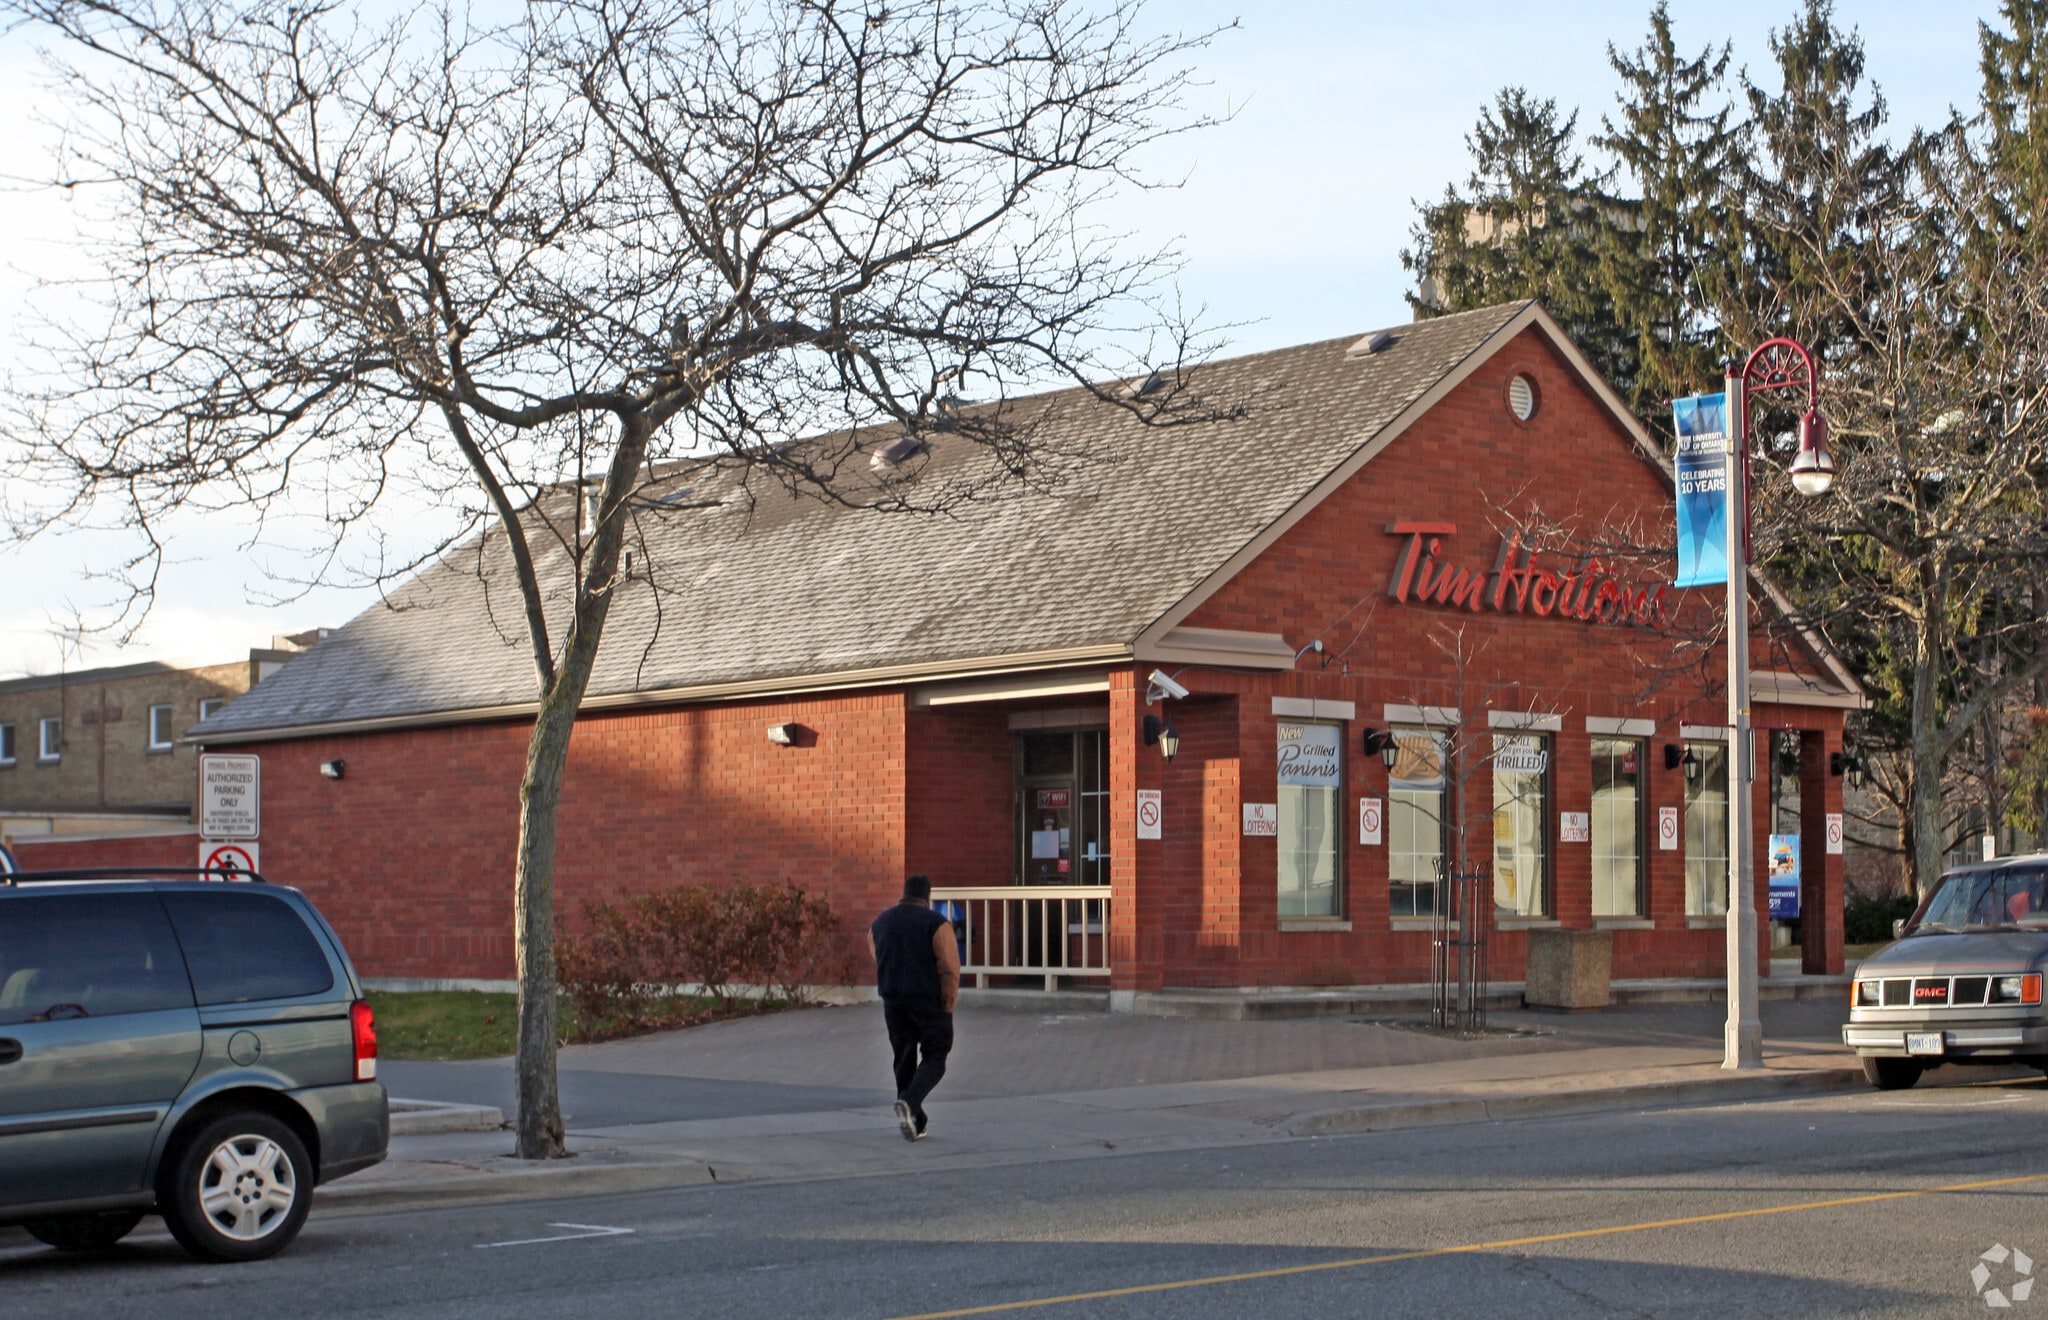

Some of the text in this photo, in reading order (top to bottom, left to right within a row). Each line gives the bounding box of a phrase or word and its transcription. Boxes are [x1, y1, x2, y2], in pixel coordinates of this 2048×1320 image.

[1692, 432, 1723, 442] UNIVERSITY
[1692, 441, 1700, 450] OF
[1681, 468, 1725, 481] CELEBRATING
[1681, 479, 1726, 495] 10 YEARS
[1386, 521, 1666, 627] Tim Hortons
[1279, 726, 1305, 741] New
[1303, 744, 1336, 757] Grilled
[1278, 743, 1339, 778] Paninis
[1495, 752, 1547, 771] HRILLED!
[207, 773, 253, 783] AUTHORIZED
[214, 785, 246, 796] PARKING
[220, 797, 238, 807] ONLY
[1254, 804, 1264, 819] NO
[1570, 814, 1578, 826] NO
[1244, 820, 1276, 834] LOITERING
[1915, 987, 1947, 998] GMC
